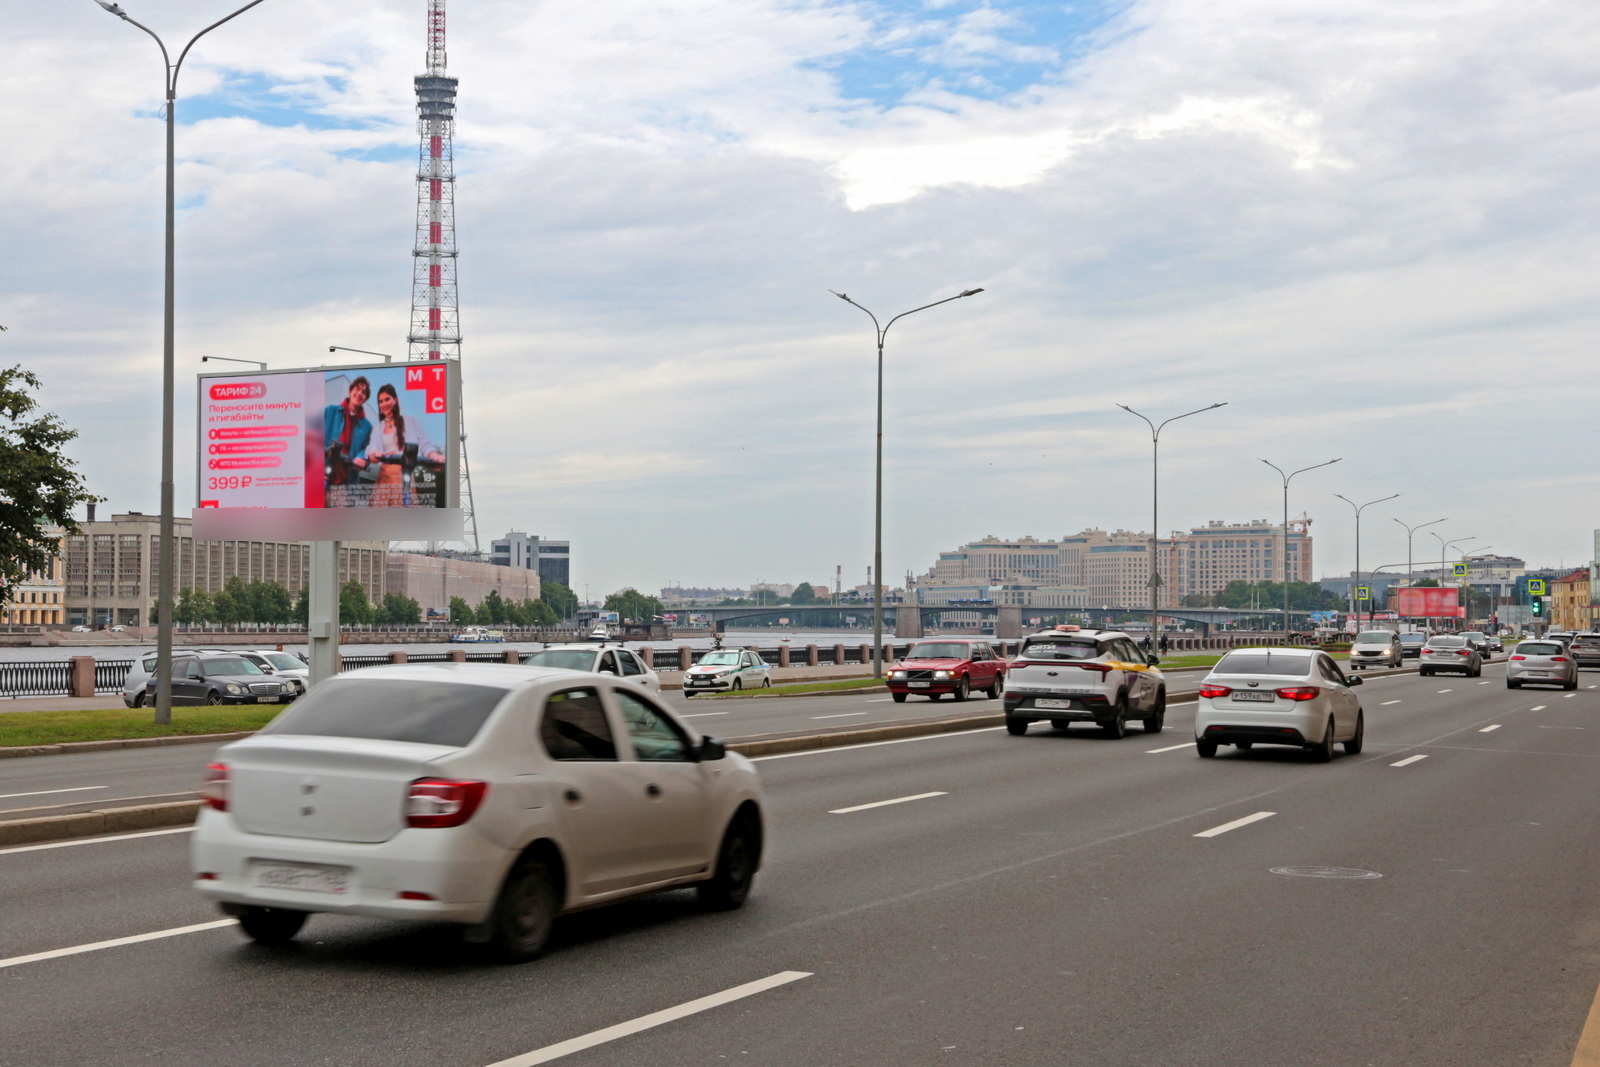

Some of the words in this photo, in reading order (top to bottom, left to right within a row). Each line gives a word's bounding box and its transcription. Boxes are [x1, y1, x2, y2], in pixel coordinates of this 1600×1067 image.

[215, 387, 248, 397] ТАРИФ
[249, 386, 262, 395] 24
[209, 402, 264, 413] Переносите
[265, 402, 301, 411] минуты
[216, 413, 264, 422] гигабайты
[209, 476, 239, 490] 399
